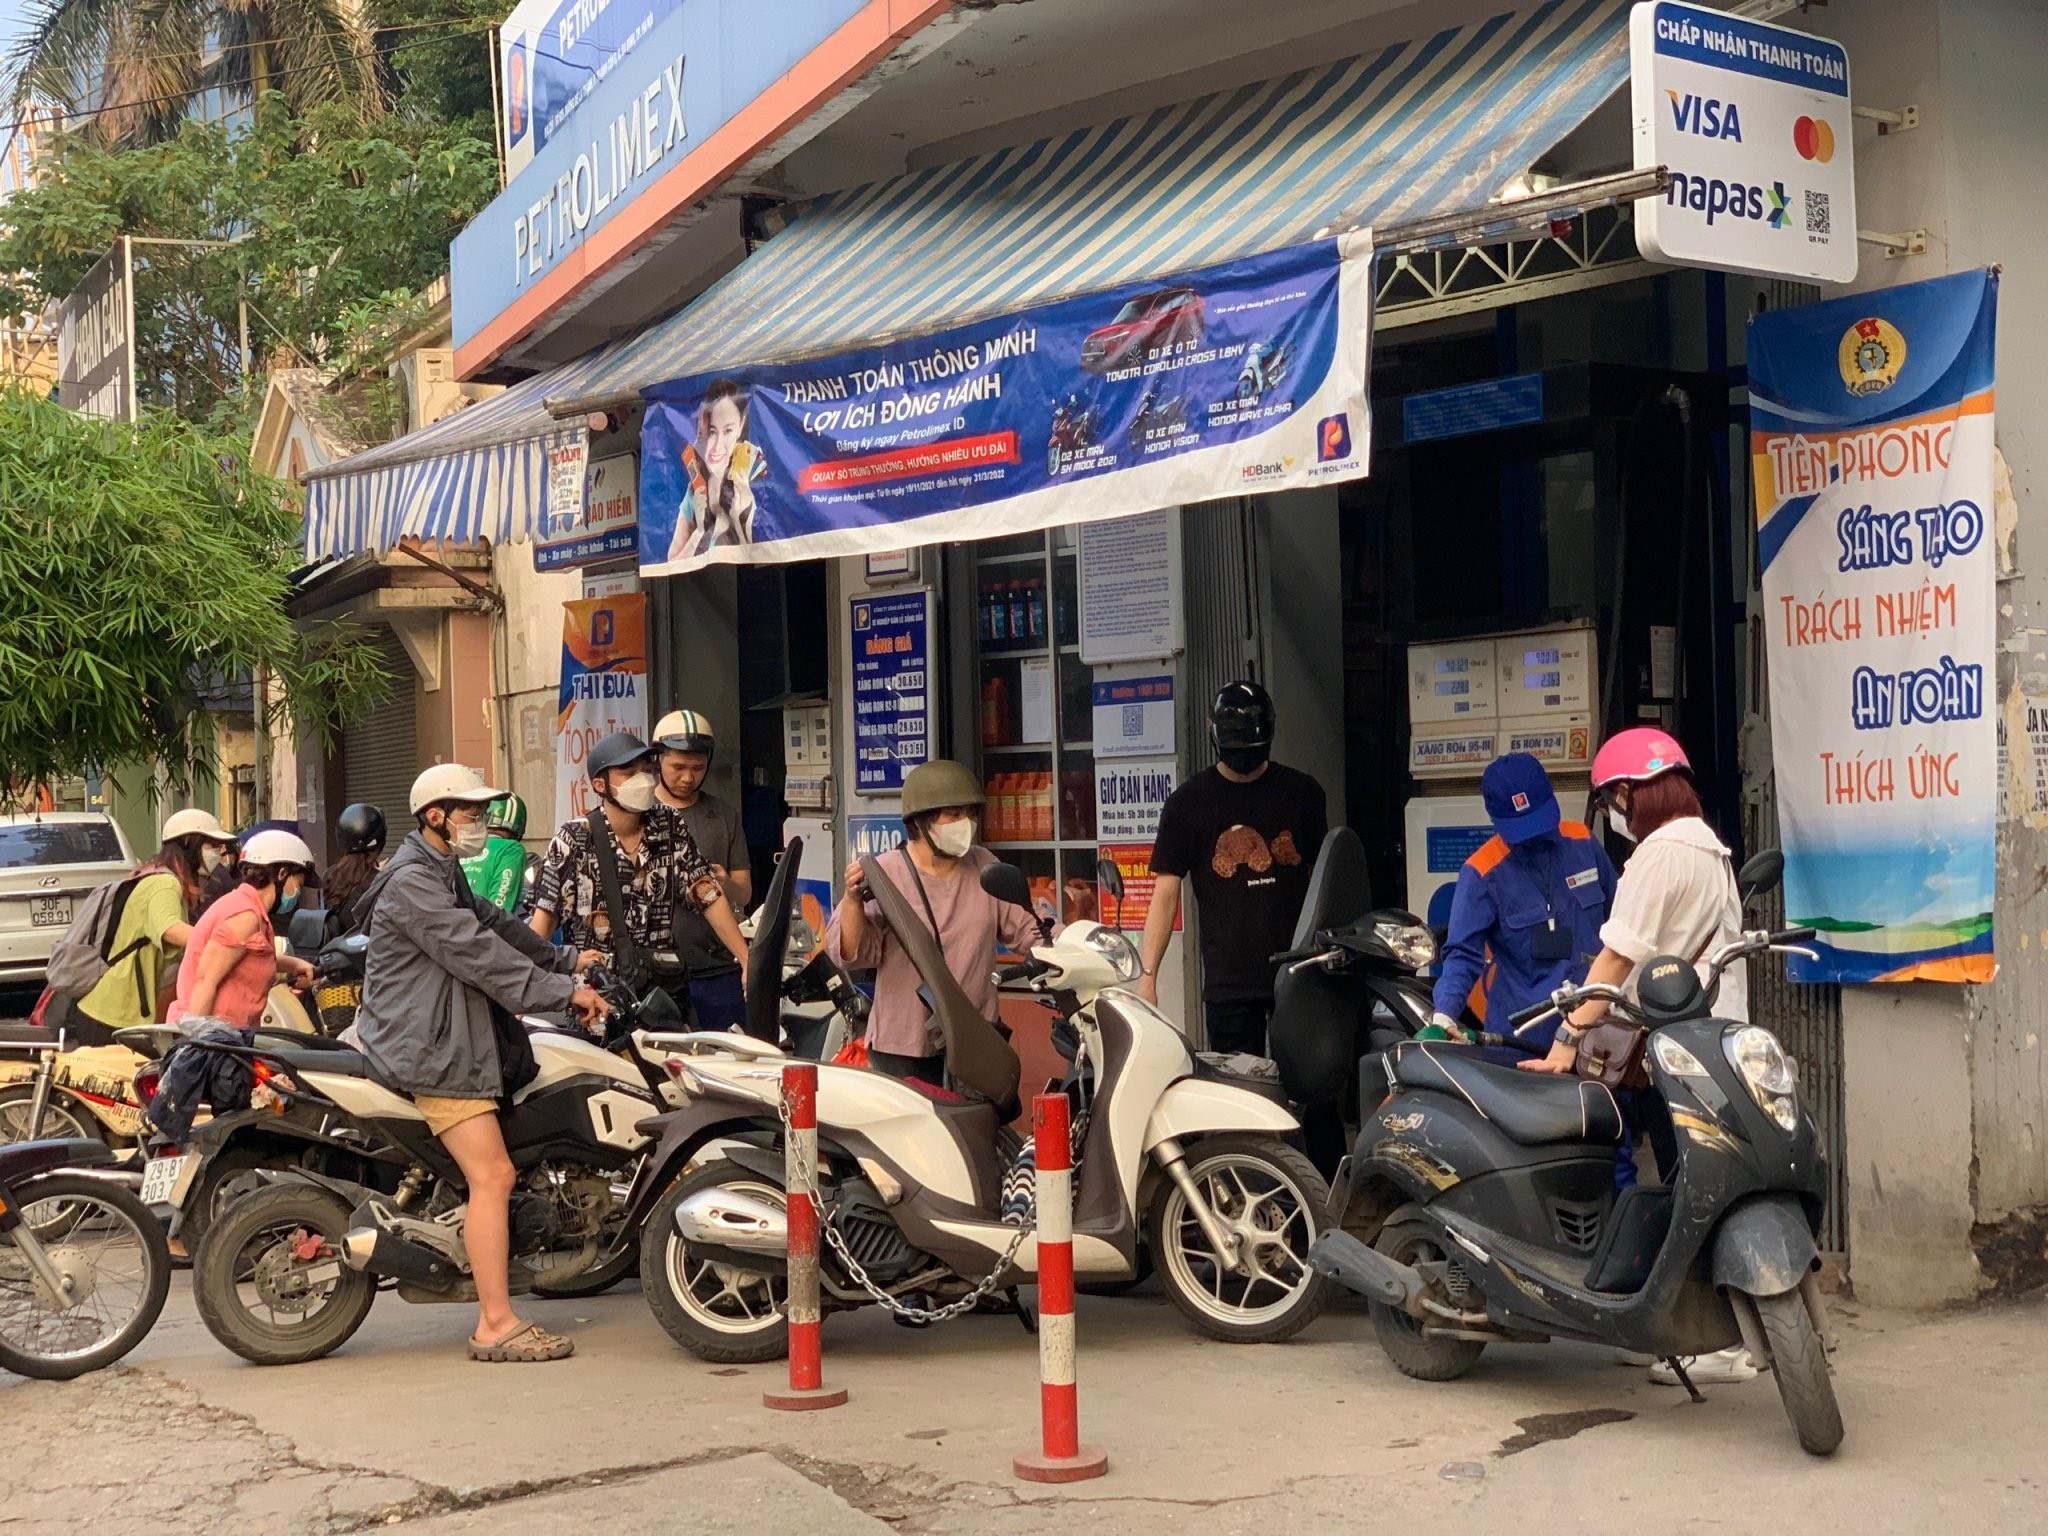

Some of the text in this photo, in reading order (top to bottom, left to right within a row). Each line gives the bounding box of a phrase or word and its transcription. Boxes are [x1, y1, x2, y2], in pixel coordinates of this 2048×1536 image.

[1656, 16, 1843, 81] CHẤP NHẬN THANH TOÁN
[1664, 88, 1742, 143] VISA
[515, 53, 688, 287] PETROLIMEX
[1667, 171, 1763, 225] napas
[1808, 235, 1829, 245] QR PAY
[1162, 345, 1173, 357] XE
[782, 328, 1036, 403] THANH TOÁN THÔNG MINH
[1106, 343, 1245, 383] TOYOTA COROLLA CROSS 1.8HV
[803, 373, 1001, 436] LỢI ÍCH ĐỒNG HÀNH
[1208, 402, 1223, 413] 100
[1226, 400, 1237, 410] XE
[1208, 402, 1292, 427] HONDA WAVE ALPHA
[836, 417, 965, 453] Đăng ký ngay Petrolimex ID
[1155, 427, 1166, 437] XE
[1061, 452, 1073, 461] 02
[1075, 449, 1085, 459] XE
[1145, 434, 1200, 454] HONDA VISION
[812, 471, 836, 482] QUAY
[849, 467, 871, 478] TRÚNG
[907, 456, 940, 469] HƯỞNG
[942, 448, 969, 463] NHIỀU
[972, 446, 987, 458] ƯU
[989, 442, 1007, 455] ĐÃI
[1061, 455, 1117, 474] SH MODE 2021
[1242, 462, 1283, 478] HDBank
[1308, 462, 1360, 476] PETROLIMEX
[1770, 426, 1952, 496] TIÊN PHONG
[905, 480, 935, 493] 19/11/2021
[973, 469, 1004, 482] 31/3/2022
[1838, 499, 1983, 573] SÁNG TẠO
[1780, 577, 1956, 647] TRÁCH NHIỆM
[866, 634, 893, 655] BẢNG
[573, 671, 636, 700] THI ĐUA
[1853, 666, 1893, 729] AN
[1897, 656, 1981, 723] TOÀN
[898, 721, 923, 733] 29.630
[1446, 741, 1466, 754] RON
[1468, 739, 1491, 752] 95-III
[1511, 736, 1561, 750] E5 RON 92-II
[1820, 745, 1959, 804] THÍCH ỨNG
[1100, 768, 1172, 805] GIỜ BÁN HÀNG
[1102, 808, 1116, 820] Mùa
[1128, 810, 1136, 819] 5h
[1137, 809, 1145, 819] 30
[1146, 806, 1158, 819] đến
[856, 824, 902, 854] LỐI VÀO
[1102, 823, 1116, 835] Mùa
[1137, 823, 1146, 834] 6h
[40, 897, 61, 911] 30F
[32, 910, 70, 924] 058.91
[1652, 963, 1679, 980] SYM
[1404, 1112, 1425, 1129] 50
